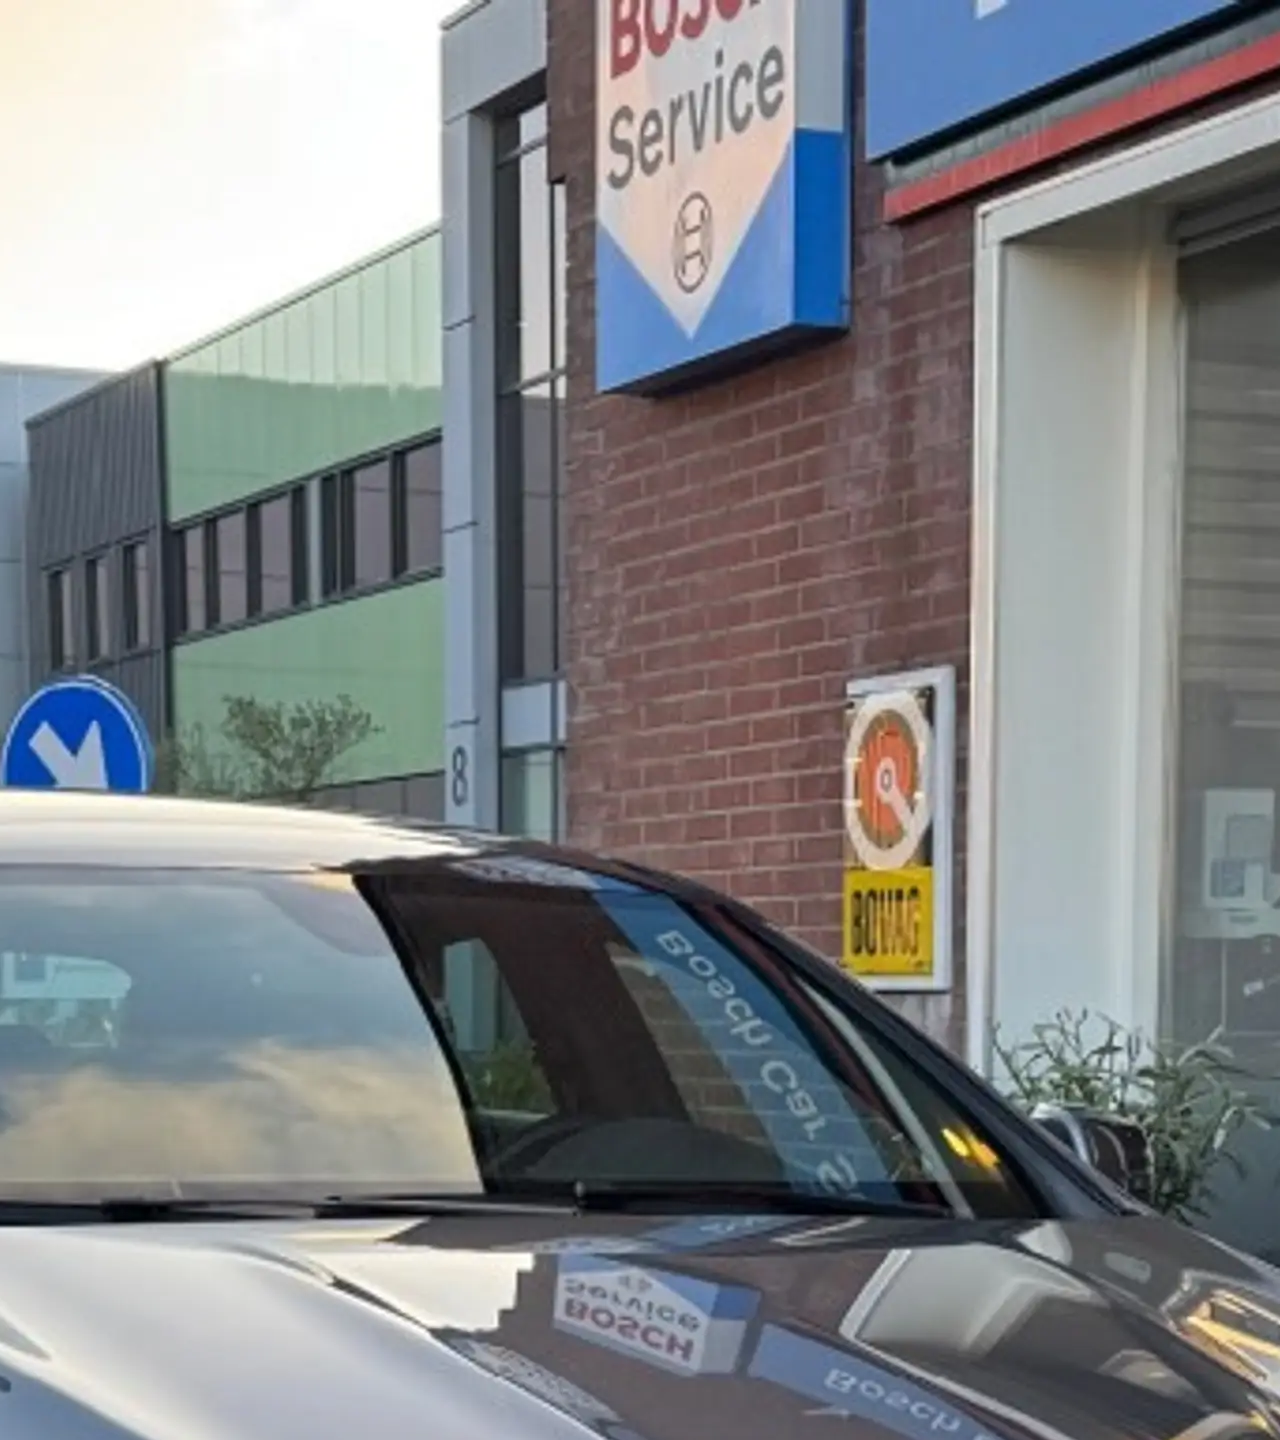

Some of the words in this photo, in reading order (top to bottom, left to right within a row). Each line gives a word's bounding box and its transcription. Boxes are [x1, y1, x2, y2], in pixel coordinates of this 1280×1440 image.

[607, 45, 785, 190] Service
[452, 745, 468, 807] 8
[851, 886, 919, 957] BOVAG
